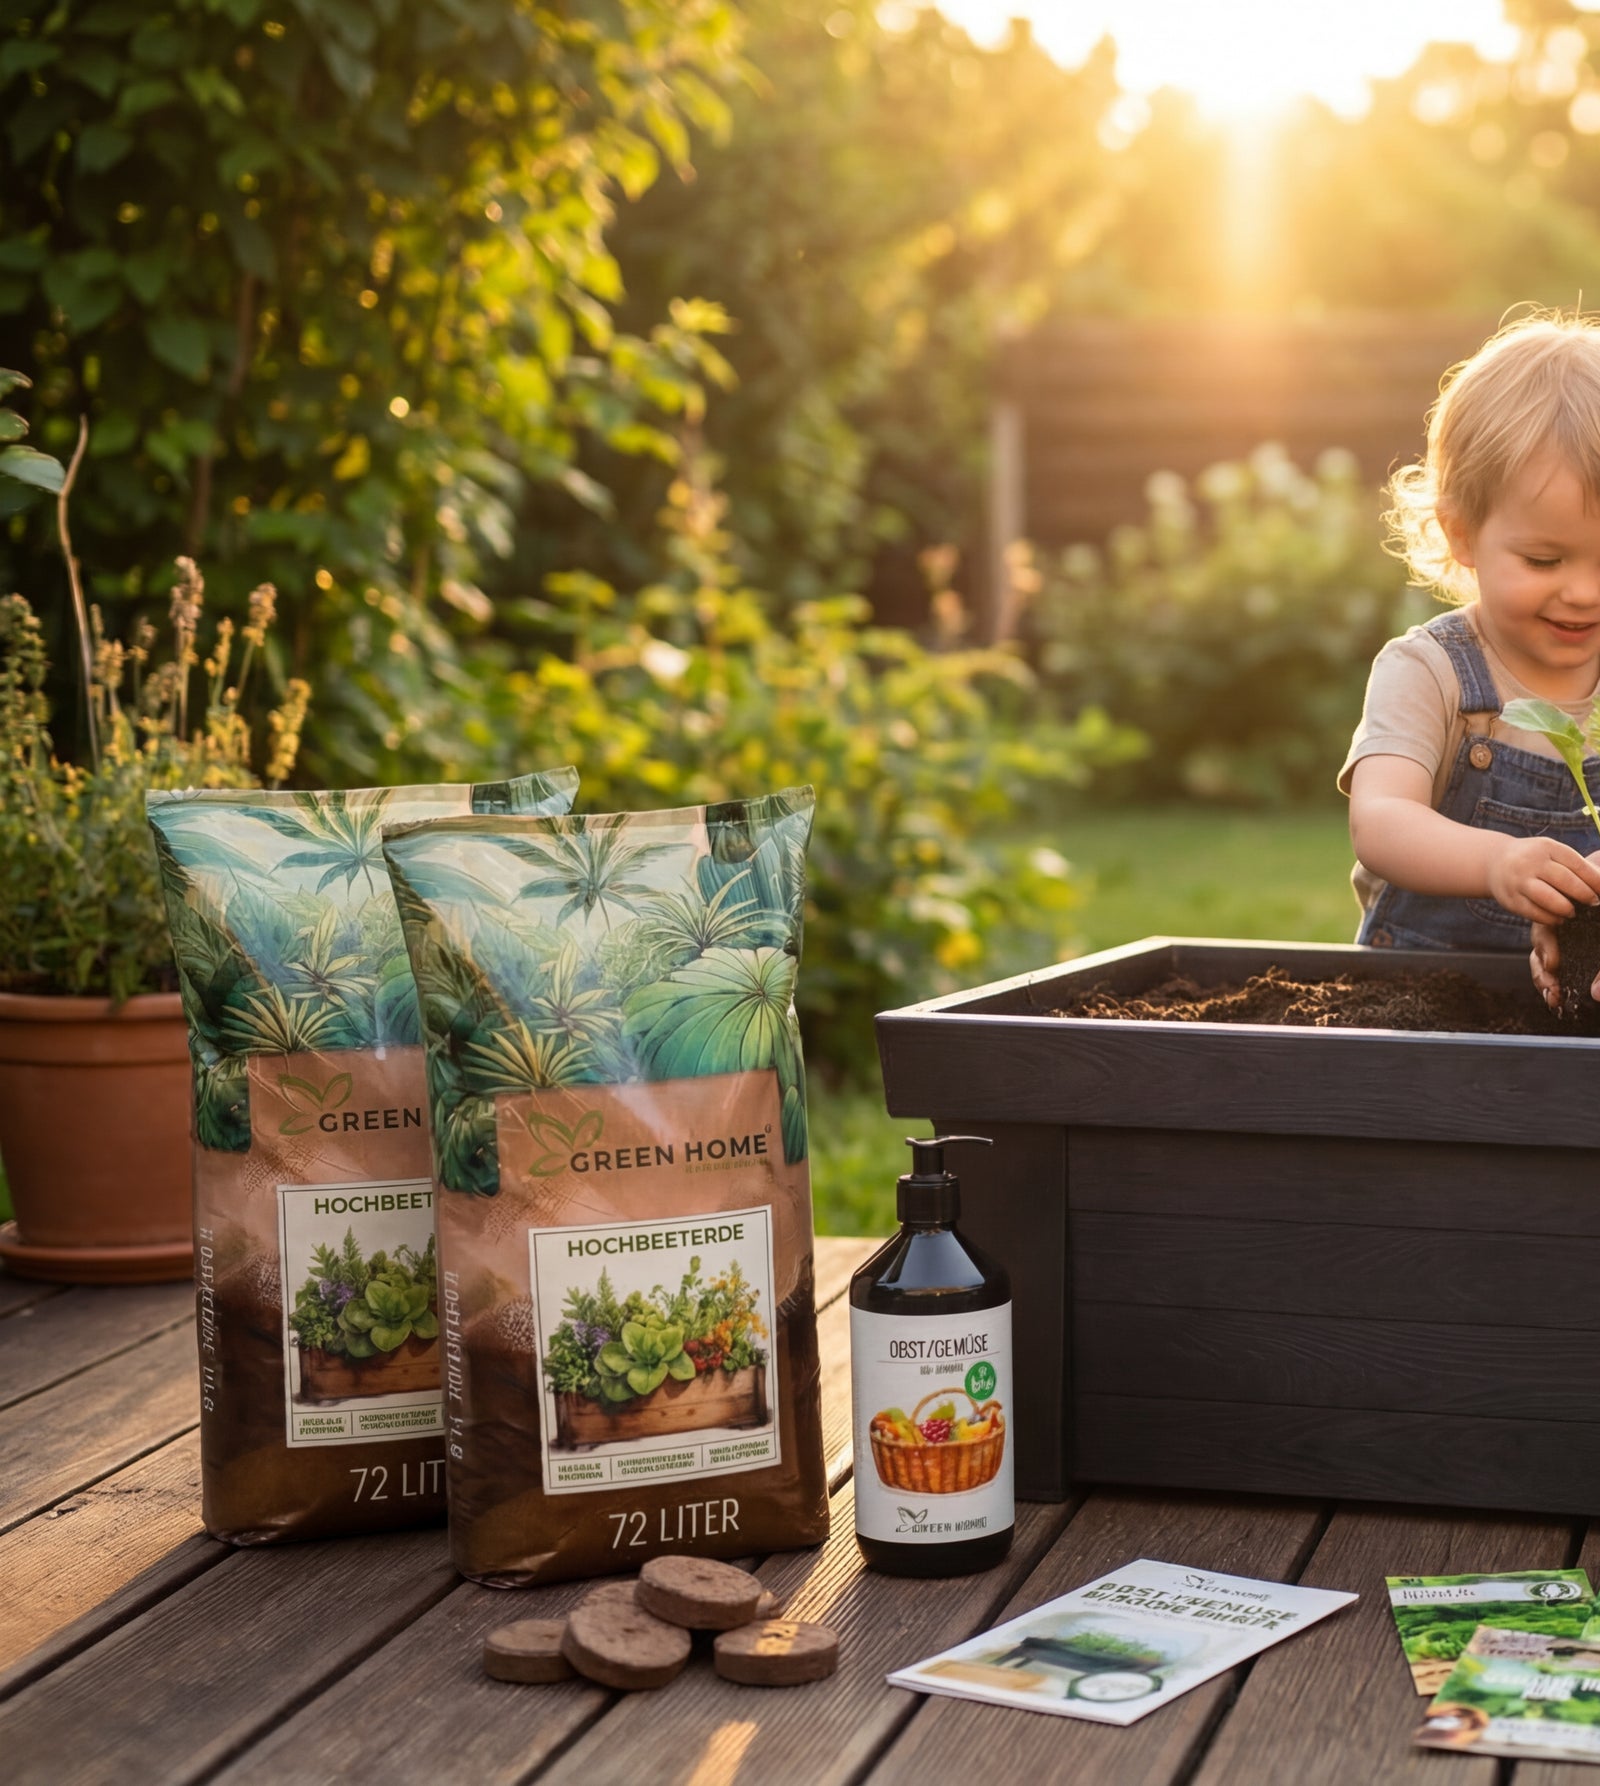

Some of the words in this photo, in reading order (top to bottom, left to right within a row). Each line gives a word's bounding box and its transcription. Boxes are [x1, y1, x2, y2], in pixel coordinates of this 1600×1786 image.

[318, 1107, 422, 1133] GREEN
[569, 1144, 675, 1173] GREEN
[685, 1134, 768, 1163] HOME
[567, 1223, 745, 1258] HOCHBEETERDE
[349, 1465, 389, 1503] 72
[608, 1511, 648, 1550] 72
[660, 1498, 740, 1542] LITER
